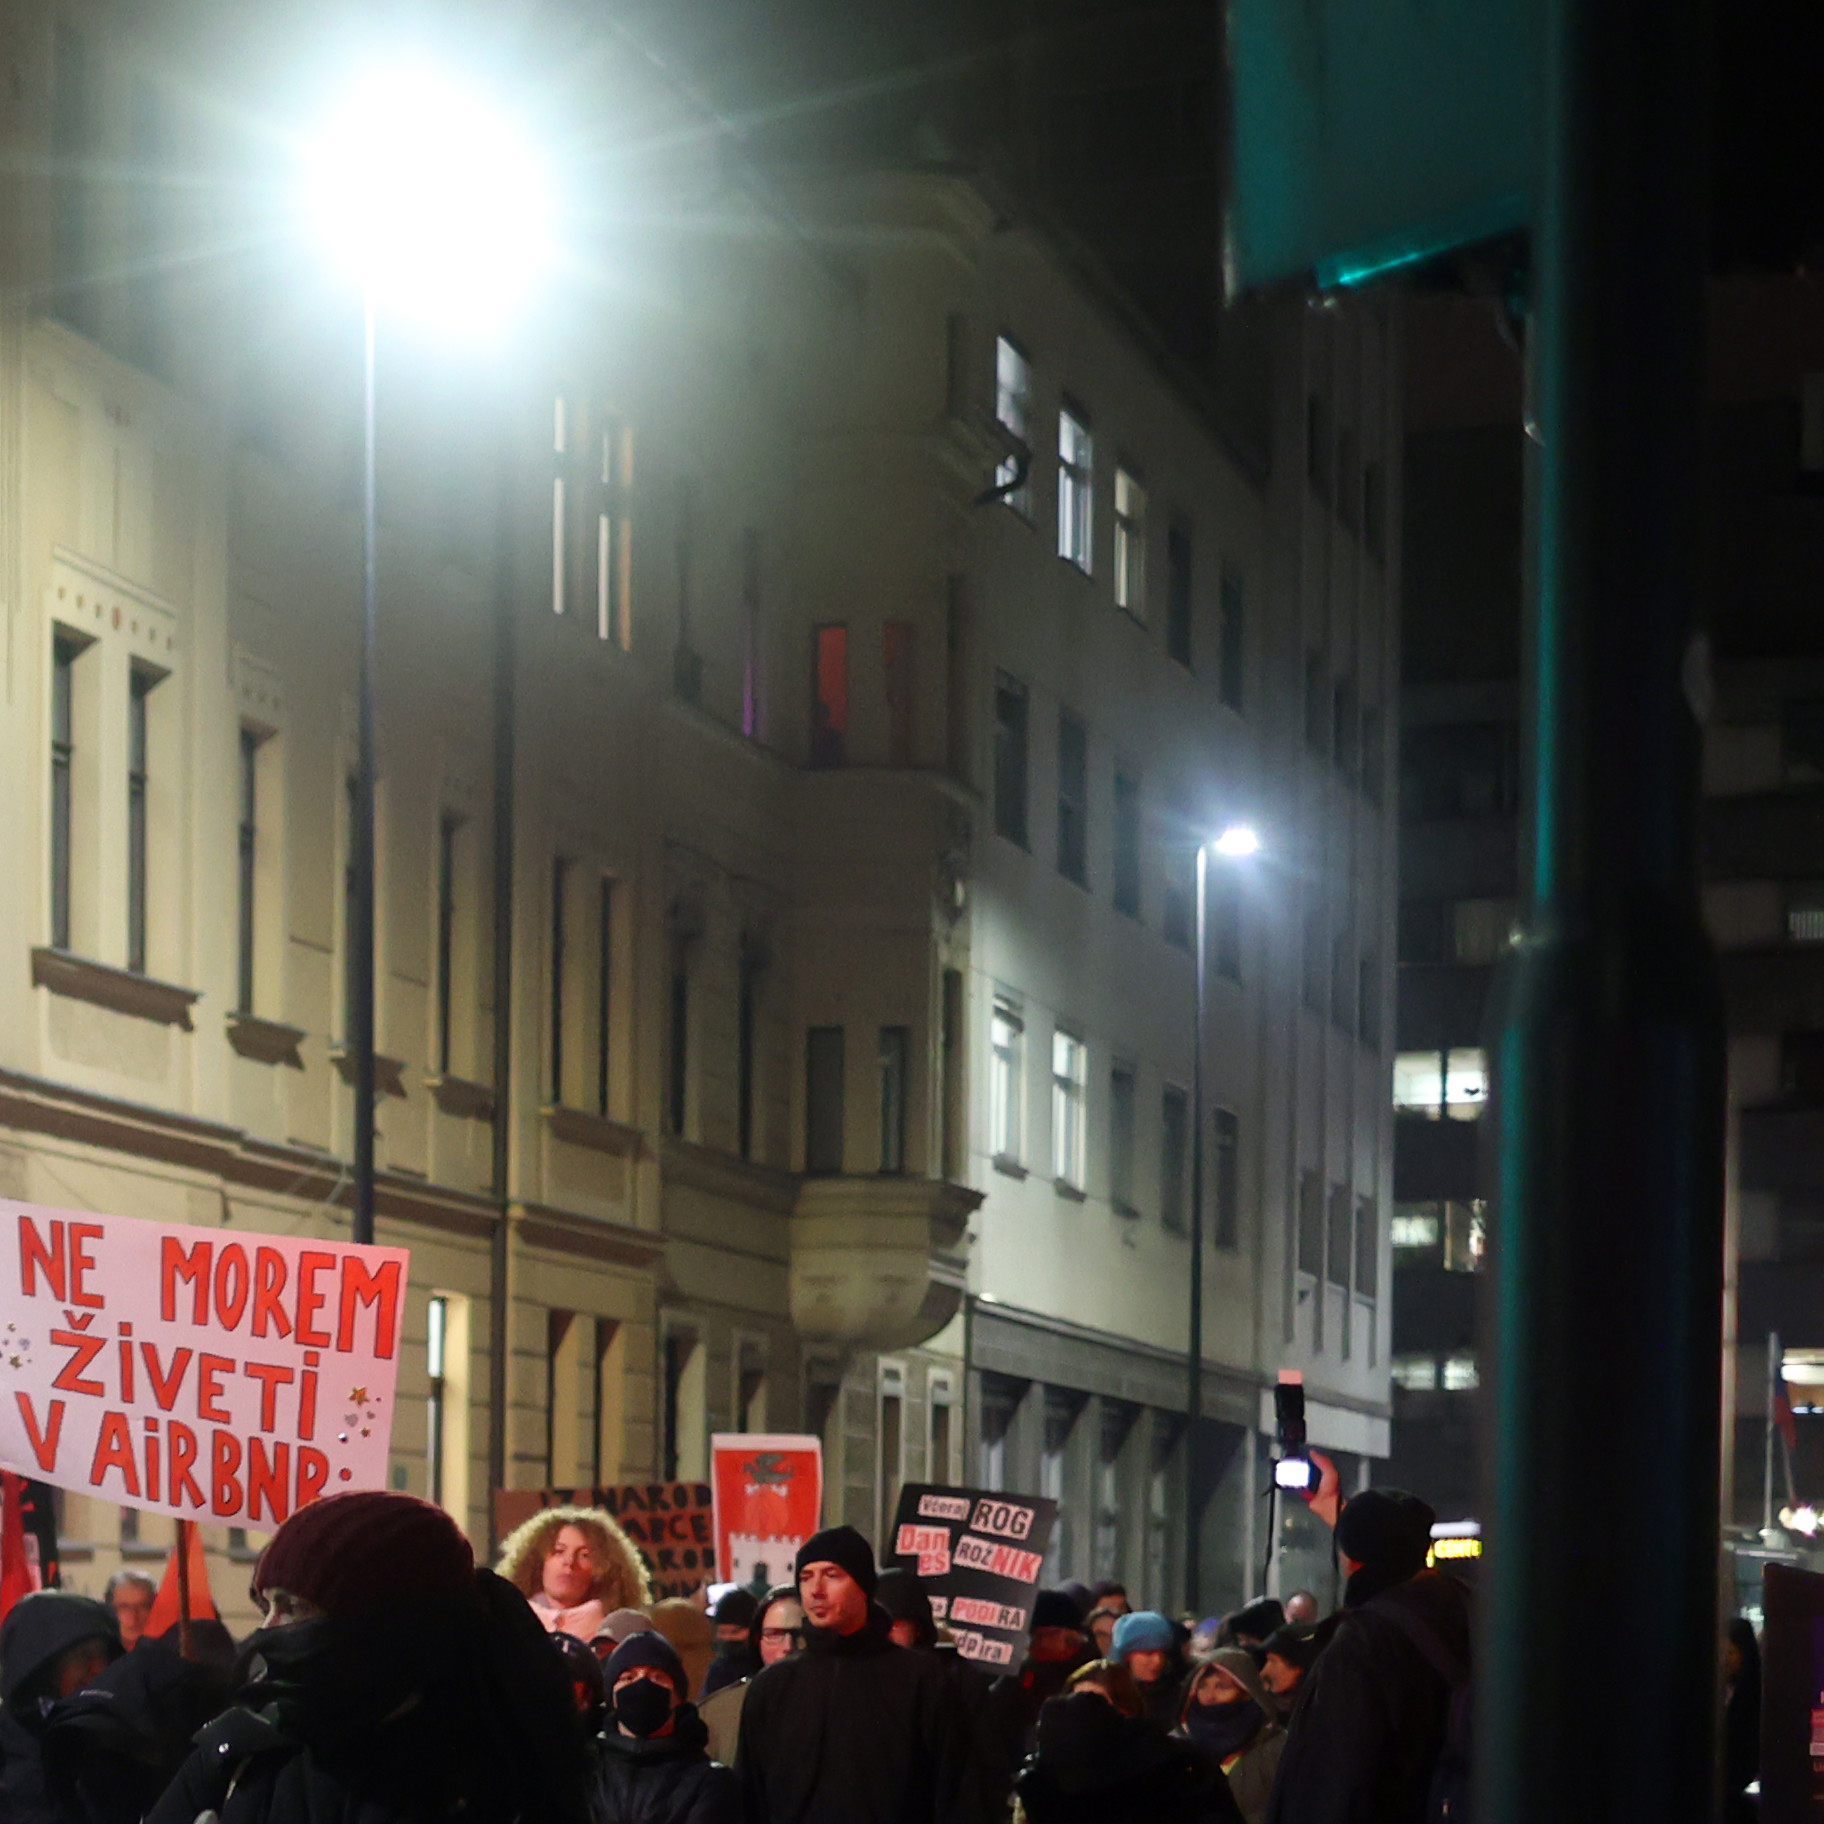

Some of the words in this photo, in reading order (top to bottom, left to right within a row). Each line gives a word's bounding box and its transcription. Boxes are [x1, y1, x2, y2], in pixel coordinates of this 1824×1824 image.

[18, 1215, 104, 1309] NE
[160, 1236, 401, 1359] MOREM
[14, 1391, 65, 1473] V
[976, 1503, 1029, 1534] ROG
